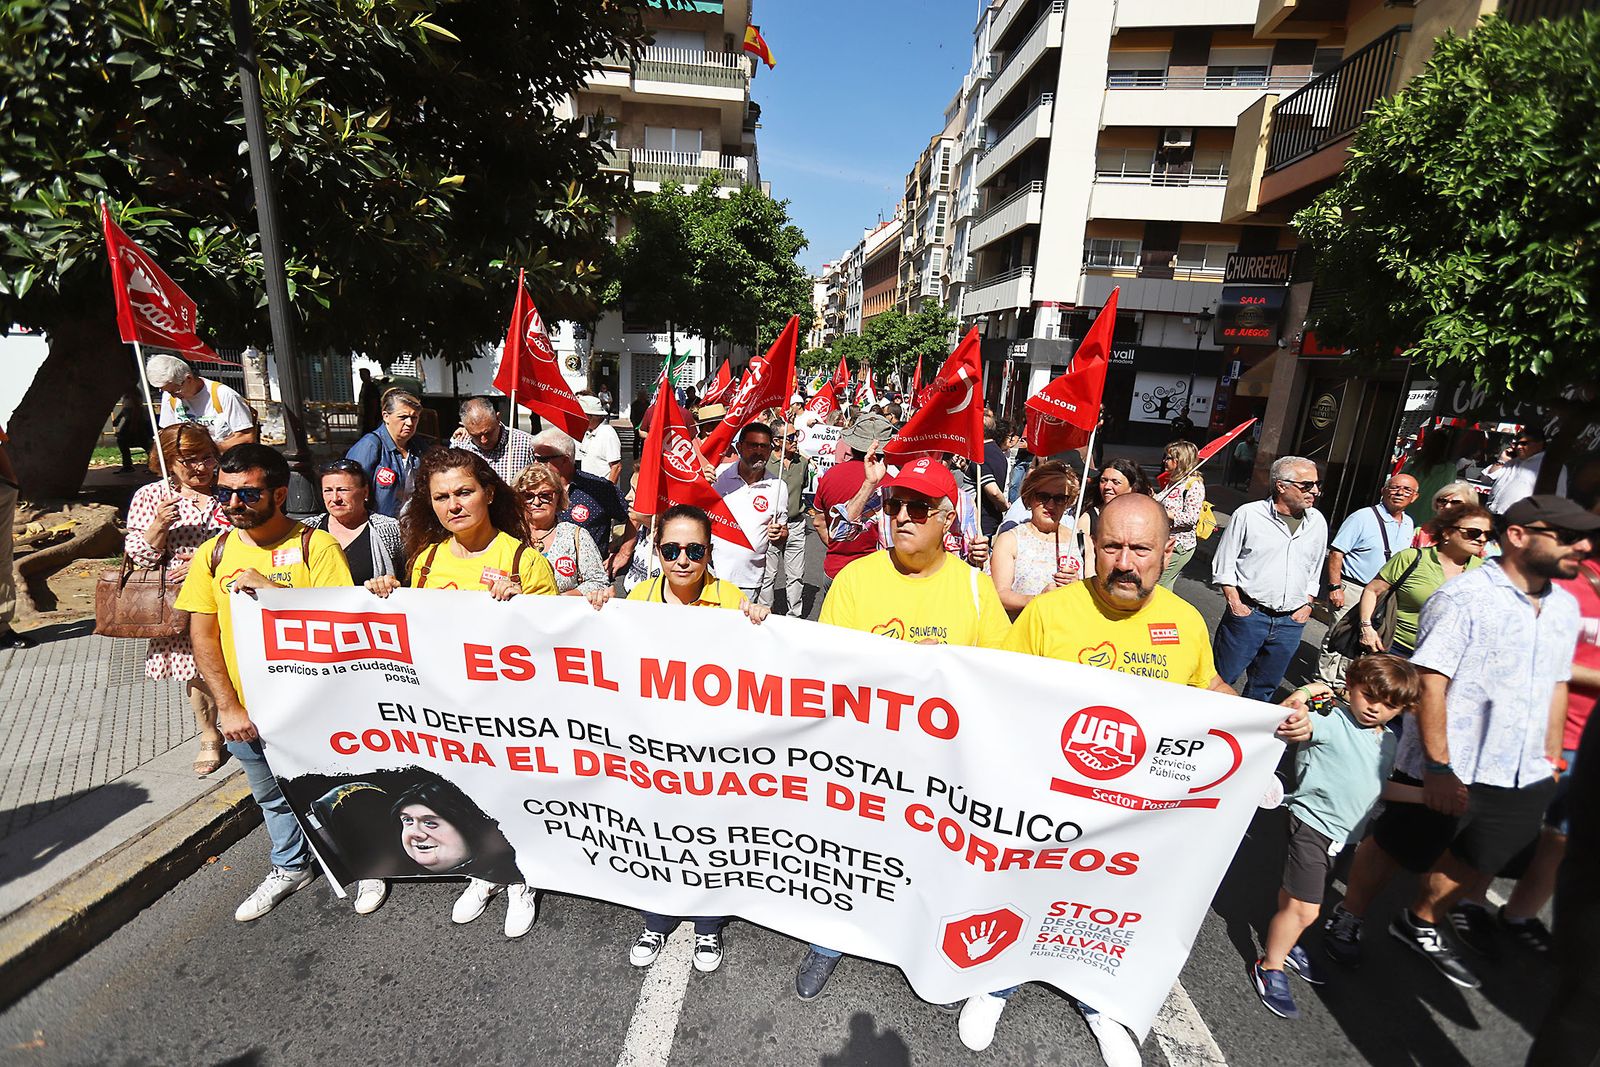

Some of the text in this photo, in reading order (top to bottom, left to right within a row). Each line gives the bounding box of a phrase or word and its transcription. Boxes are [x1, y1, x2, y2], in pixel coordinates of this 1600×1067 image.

[1226, 255, 1288, 280] CHURRERIA
[1240, 296, 1266, 305] SALA
[1223, 328, 1271, 337] DE JUEGOS
[1113, 349, 1135, 360] vall
[1037, 391, 1077, 412] cia.com
[274, 618, 402, 654] CCOO
[909, 626, 947, 639] SALVEMOS
[268, 662, 318, 676] servicios
[322, 667, 330, 676] a
[333, 663, 347, 675] la
[1123, 651, 1167, 667] SALVEMOS
[385, 673, 420, 686] postal
[1130, 666, 1170, 679] SERVICIO
[463, 643, 960, 741] ES EL MOMENTO
[1071, 713, 1138, 754] UGT
[377, 702, 1083, 843] EN DEFENSA DEL SERVICIO POSTAL PÚBLICO
[1149, 766, 1191, 782] Públicos
[1152, 756, 1197, 772] Servicios
[330, 728, 1140, 876] CONTRA EL DESGUACE DE CORREOS
[1091, 788, 1181, 810] Sector Postal
[523, 799, 913, 886] CONTRA LOS RECORTES,
[544, 819, 896, 902] PLANTILLA SUFICIENTE
[582, 852, 854, 912] Y CON DERECHOS
[1047, 901, 1142, 928] STOP
[1040, 925, 1131, 947] DE CORREOS
[1043, 917, 1135, 940] DESGUACE
[1032, 943, 1121, 968] EL SERVICIO
[1036, 932, 1126, 959] SALVAR
[1076, 956, 1117, 977] POSTAL
